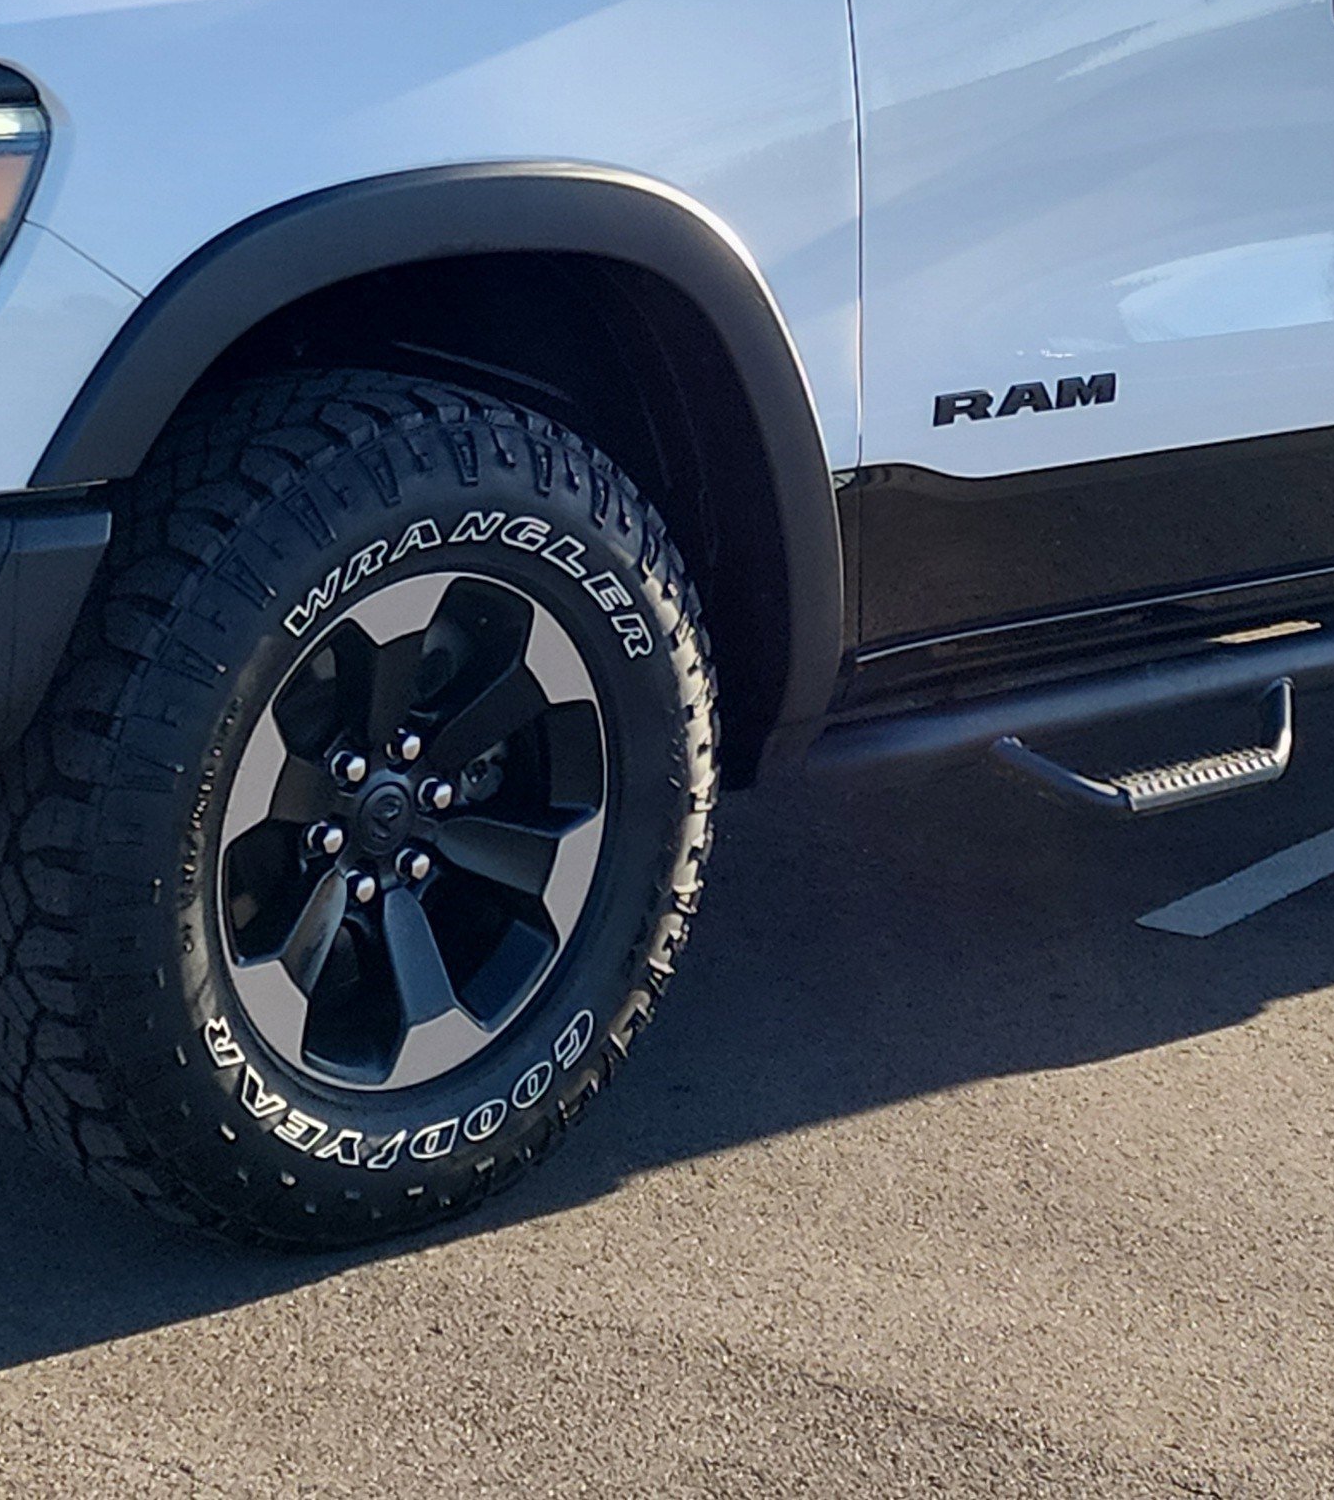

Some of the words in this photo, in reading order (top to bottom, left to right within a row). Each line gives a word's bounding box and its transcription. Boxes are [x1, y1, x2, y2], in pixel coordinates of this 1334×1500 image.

[933, 373, 1116, 427] RAM
[284, 511, 653, 658] WRANGLER
[204, 1009, 594, 1169] GOODYEAR
